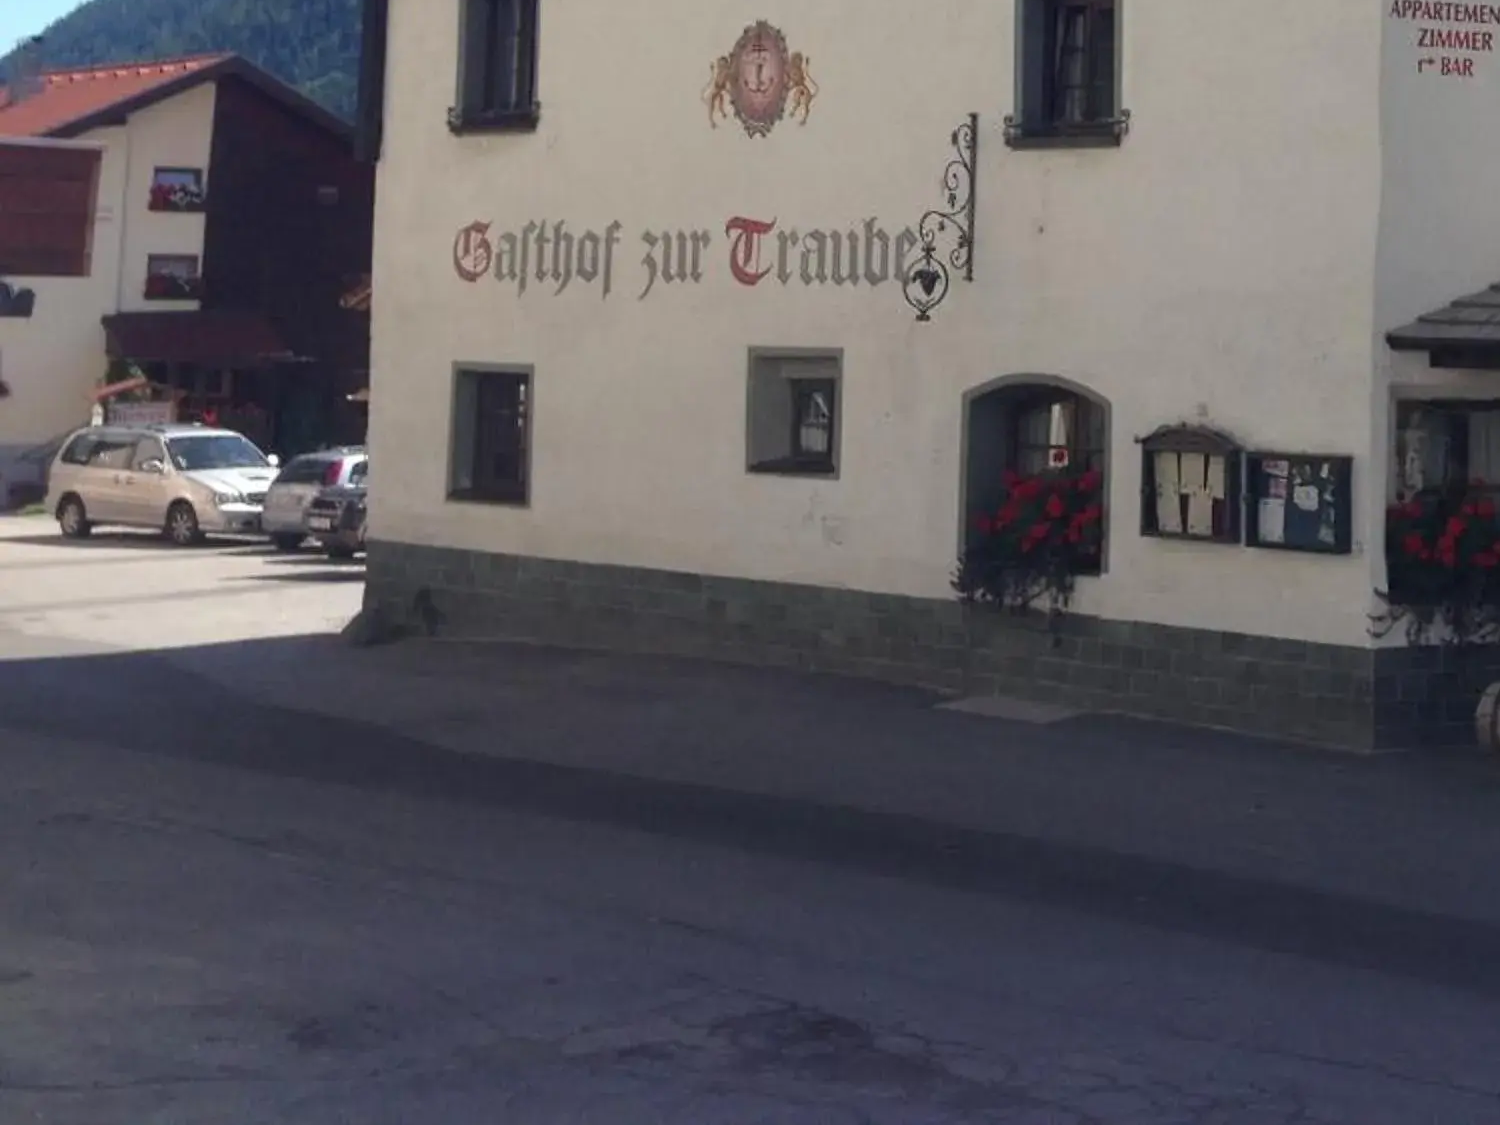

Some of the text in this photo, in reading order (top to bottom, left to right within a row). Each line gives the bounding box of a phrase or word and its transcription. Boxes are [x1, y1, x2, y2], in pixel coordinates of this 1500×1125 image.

[1417, 27, 1493, 51] ZIMMER
[1441, 56, 1474, 77] BAR
[638, 228, 711, 301] zur
[725, 215, 918, 287] Traube
